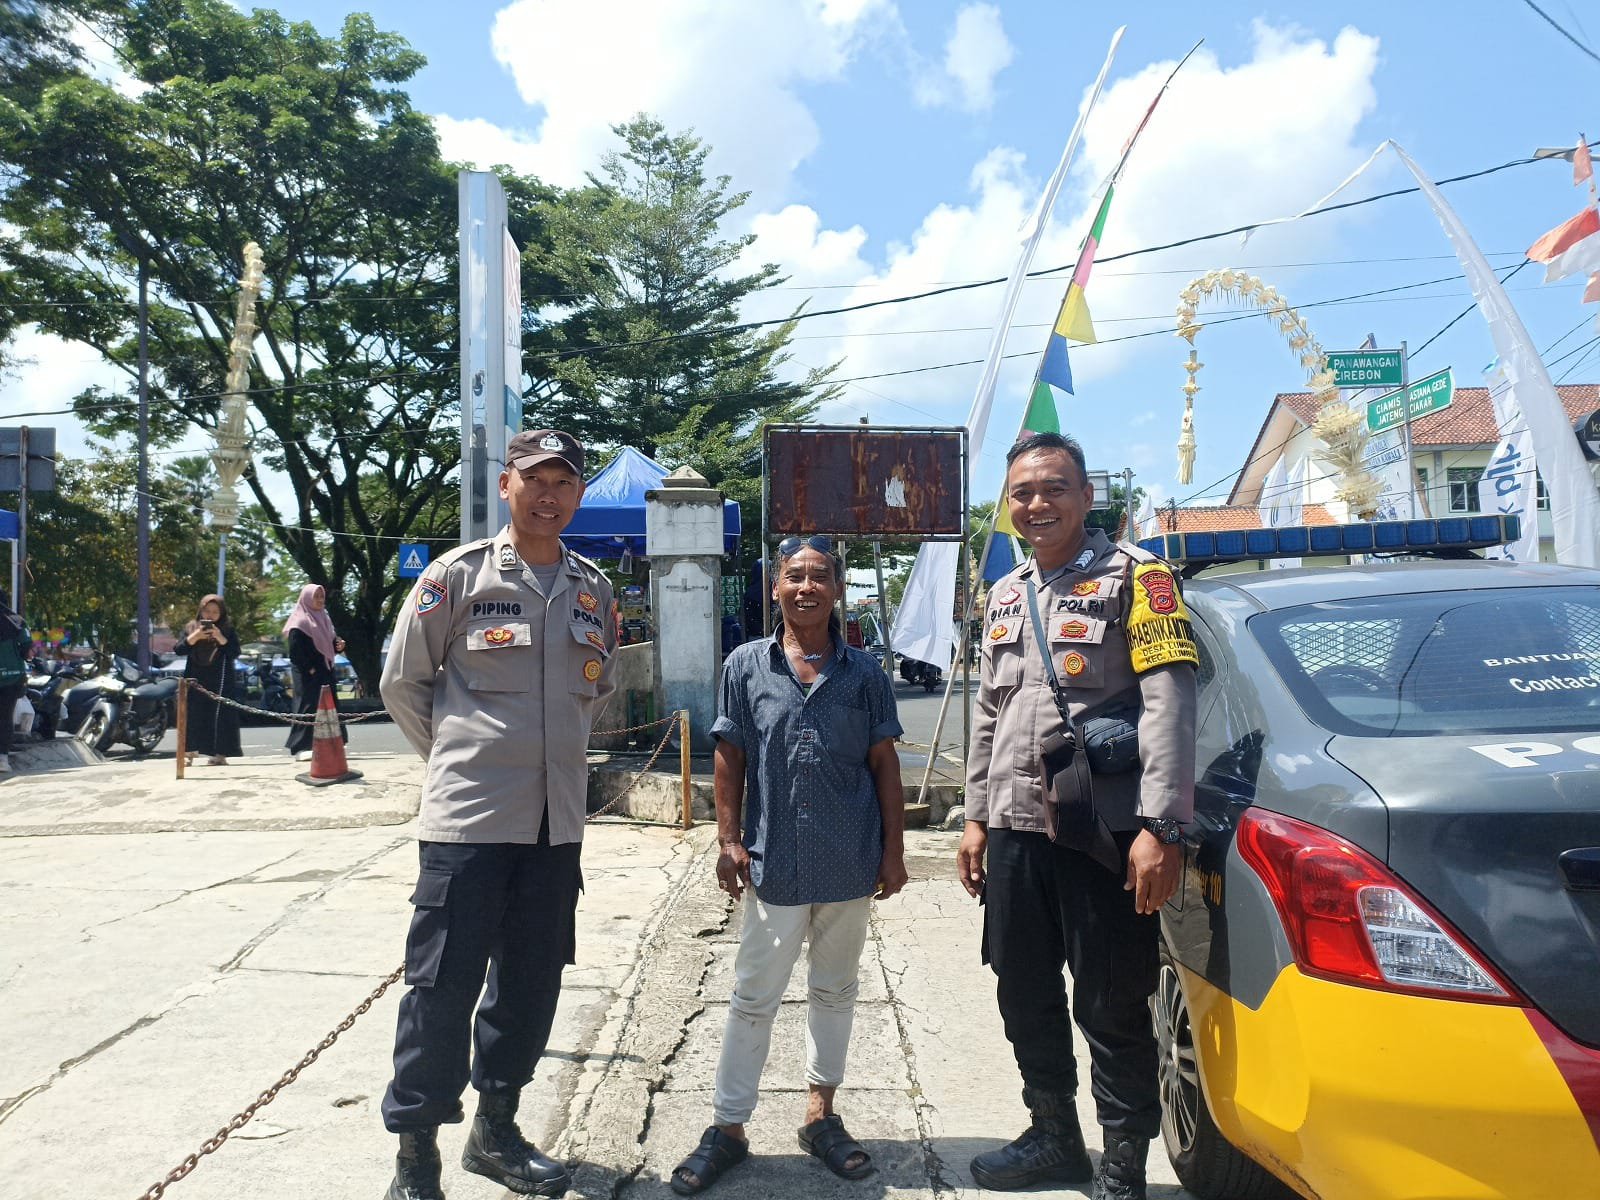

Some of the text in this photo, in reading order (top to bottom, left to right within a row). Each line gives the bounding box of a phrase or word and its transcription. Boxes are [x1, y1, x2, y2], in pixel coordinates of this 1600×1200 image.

[1333, 357, 1399, 369] PANAWANGAN
[1334, 370, 1381, 381] CIREBON
[1376, 396, 1401, 415] CIAMIS
[1409, 384, 1431, 402] ASTANA
[1377, 396, 1433, 426] JATENG CIAKAR
[473, 601, 522, 617] PIPING
[1056, 598, 1104, 613] POLRI
[1142, 643, 1165, 657] DESA
